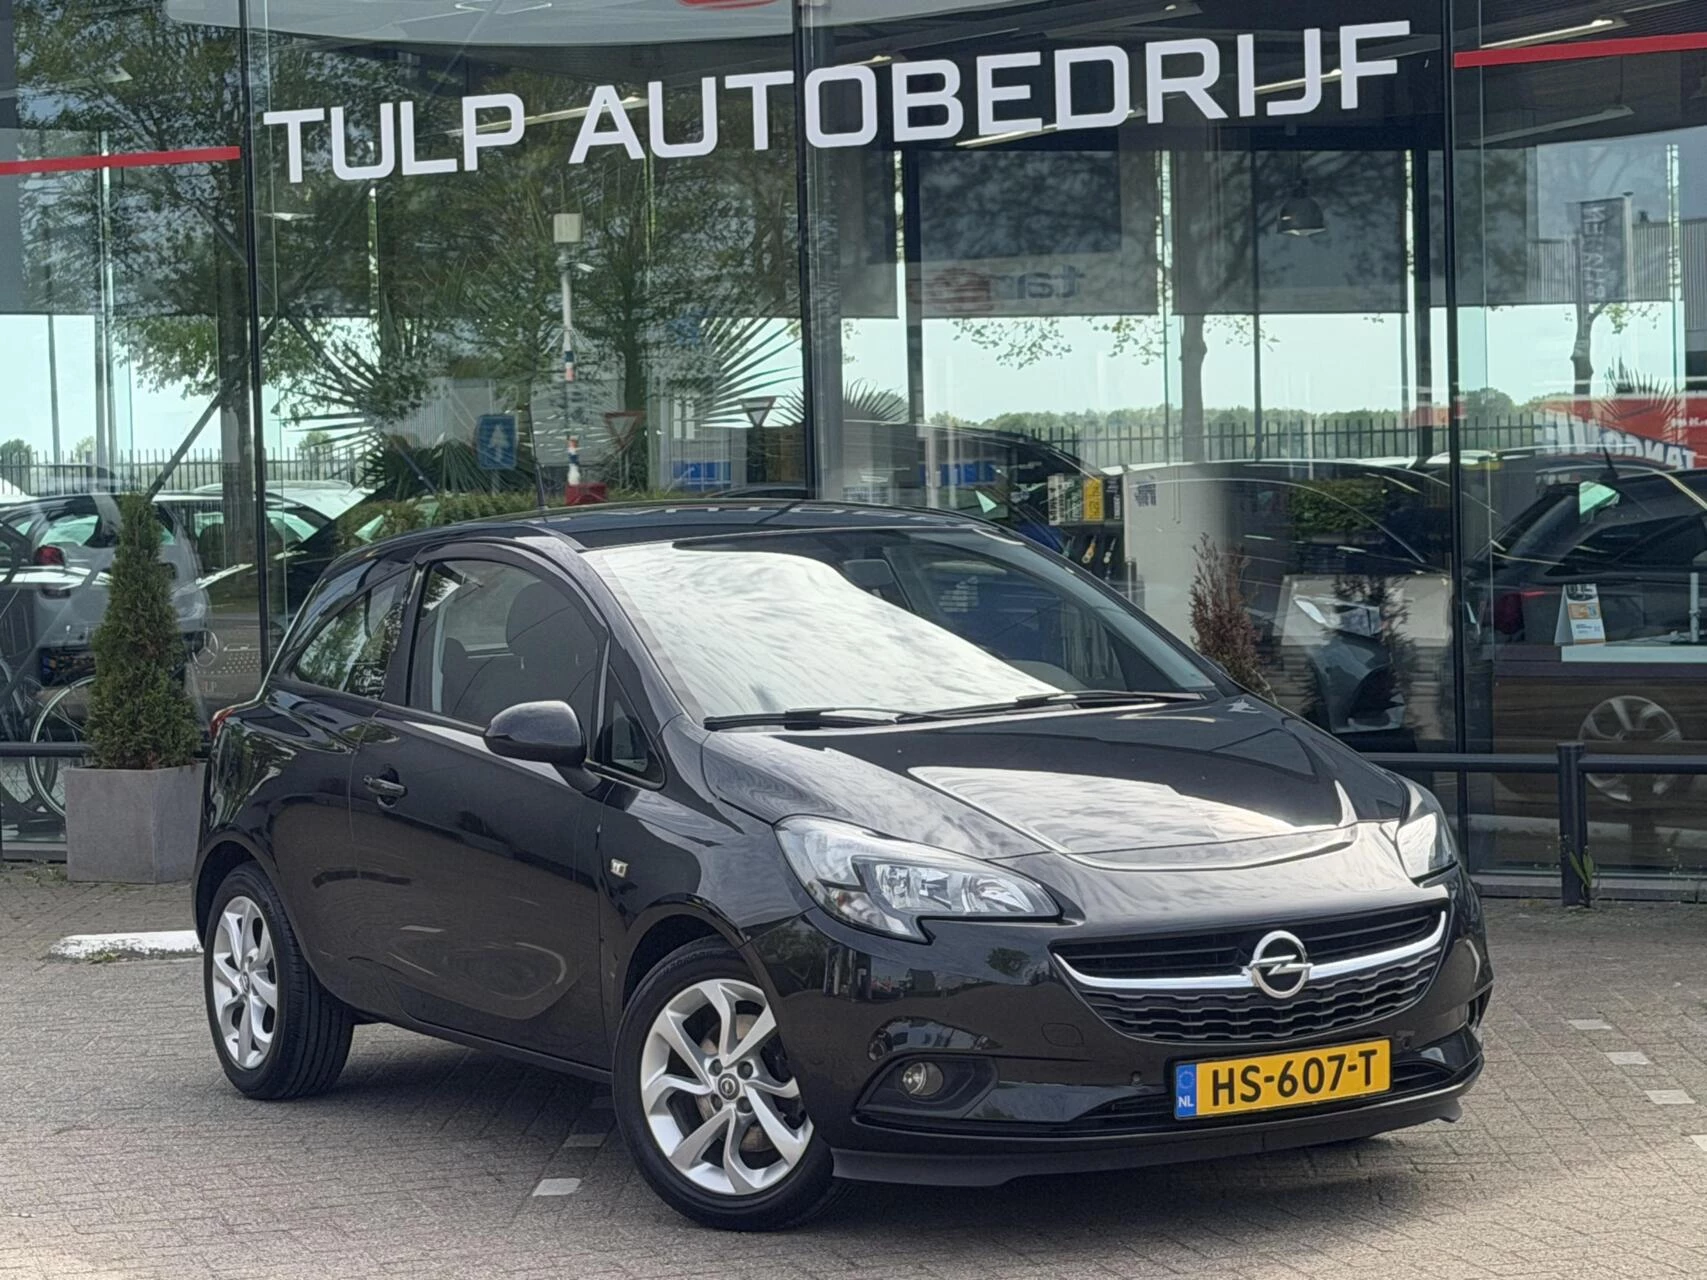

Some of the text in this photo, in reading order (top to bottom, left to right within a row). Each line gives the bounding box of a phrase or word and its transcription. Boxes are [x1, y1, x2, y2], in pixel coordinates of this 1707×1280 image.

[263, 20, 1411, 183] TULP AUTOBEDRIJF
[1178, 1094, 1194, 1109] NL
[1211, 1049, 1378, 1107] HS-607-T
